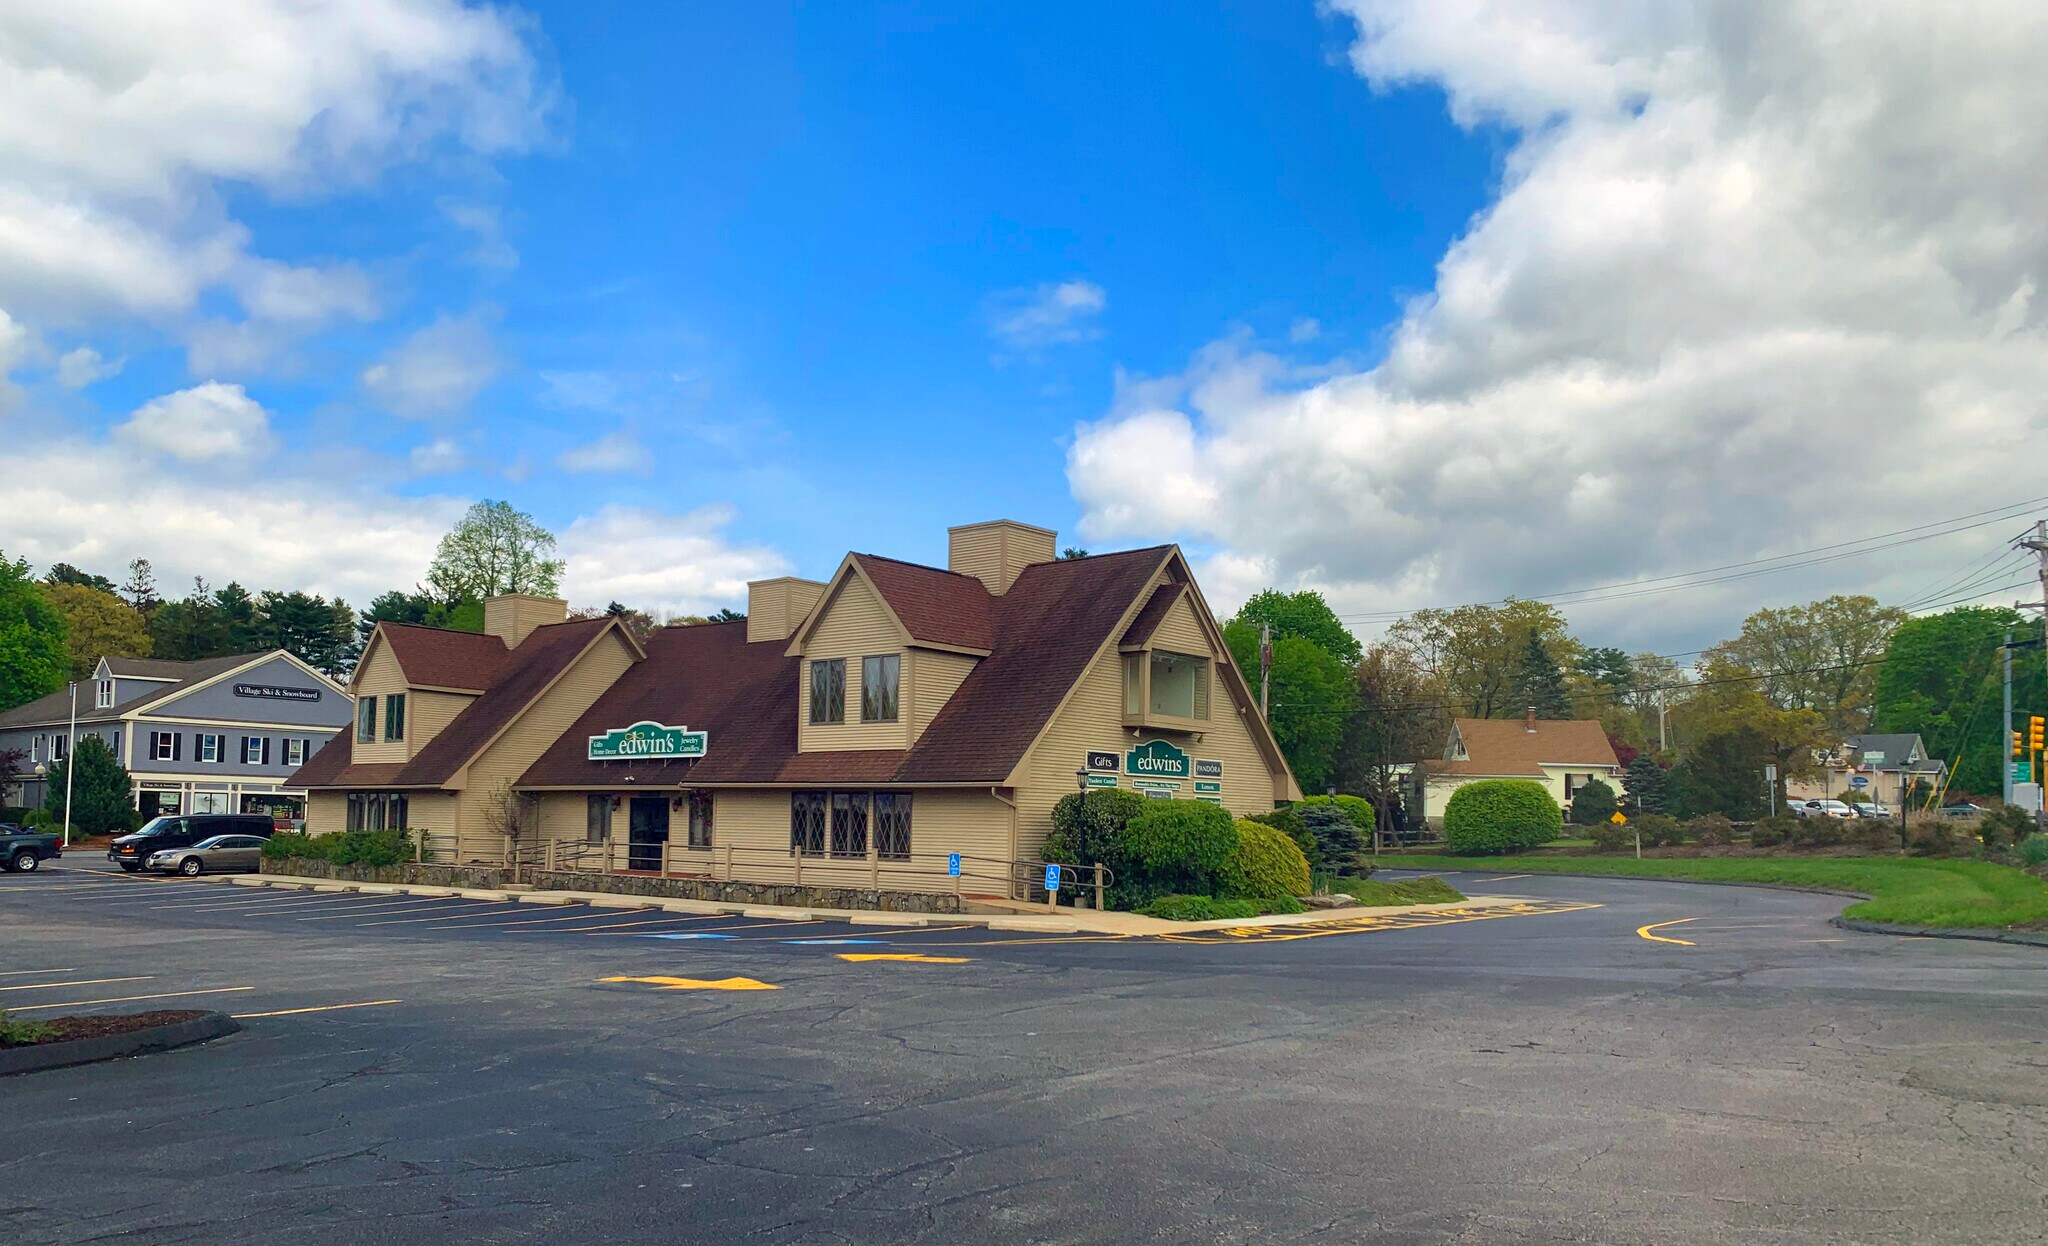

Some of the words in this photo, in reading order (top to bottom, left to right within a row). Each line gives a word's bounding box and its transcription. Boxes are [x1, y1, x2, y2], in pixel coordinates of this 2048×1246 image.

[238, 686, 261, 696] Village
[262, 688, 274, 696] Ski
[282, 690, 318, 699] Snowboard
[618, 730, 674, 754] edwin's
[1094, 756, 1112, 768] Gifts
[1138, 746, 1182, 772] edwins
